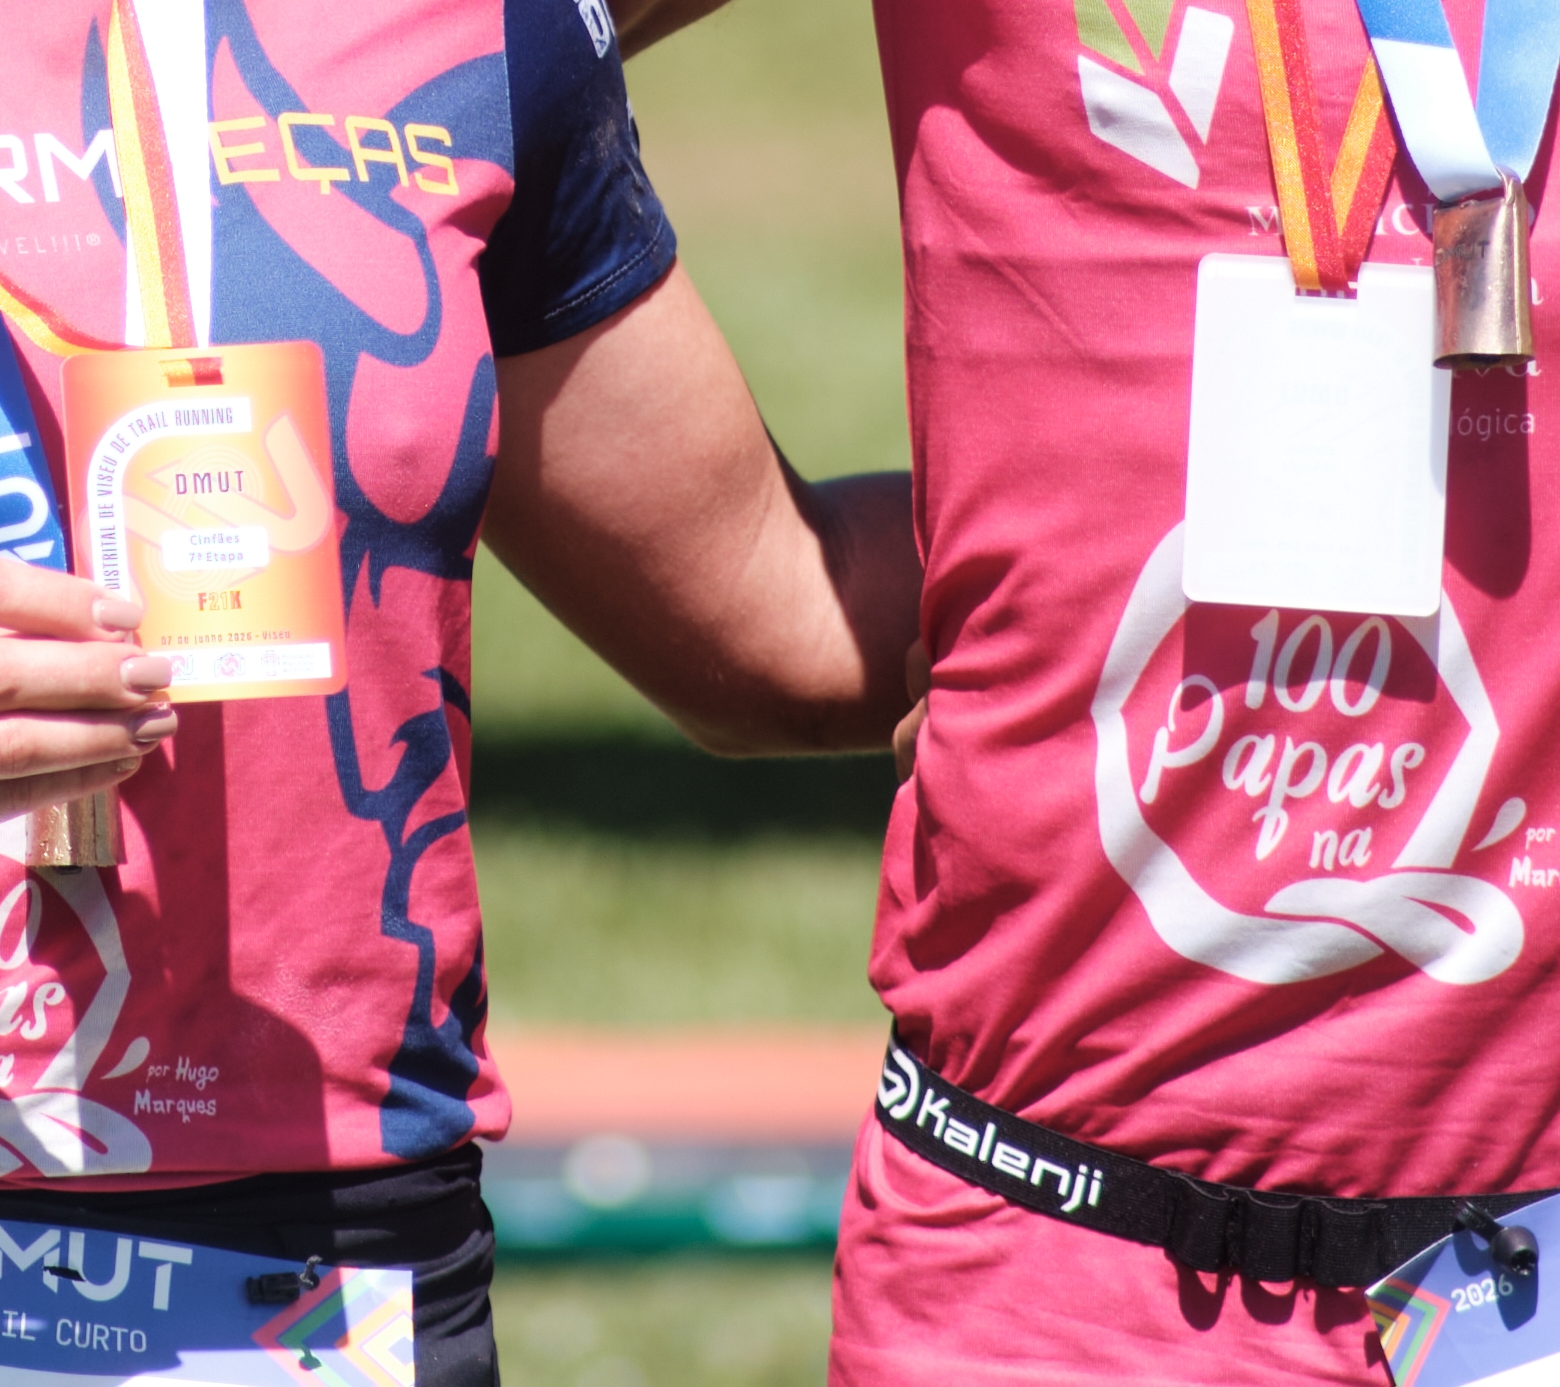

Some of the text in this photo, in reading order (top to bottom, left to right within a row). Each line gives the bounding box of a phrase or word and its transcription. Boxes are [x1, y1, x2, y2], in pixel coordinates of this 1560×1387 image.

[127, 410, 169, 438] TRAIL
[175, 406, 234, 427] RUNNING
[109, 432, 131, 454] DE
[97, 454, 119, 497] VISEU
[175, 470, 245, 495] DMUT
[98, 502, 115, 519] DE
[206, 551, 245, 564] Etapa
[197, 590, 243, 612] F21K
[1245, 608, 1393, 717] 100
[1139, 673, 1426, 861] Papas
[1309, 824, 1373, 871] na
[1525, 823, 1557, 851] por
[146, 1058, 221, 1091] por Hugo
[133, 1090, 218, 1124] Marques
[1449, 1272, 1516, 1315] 2026
[54, 1318, 149, 1356] CURTO
